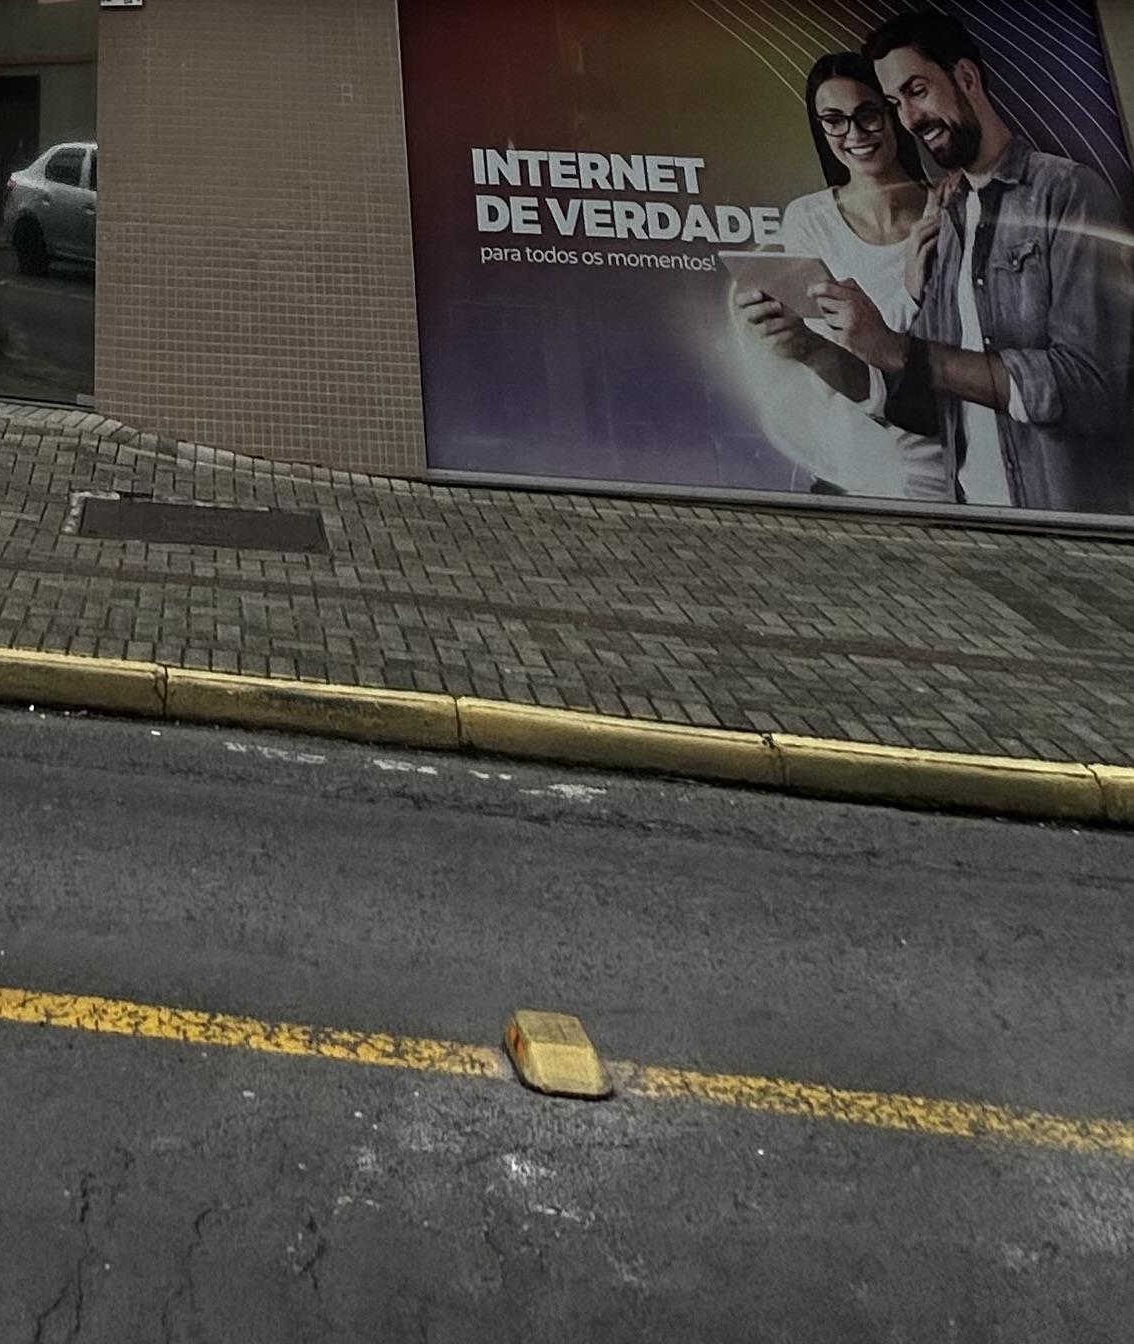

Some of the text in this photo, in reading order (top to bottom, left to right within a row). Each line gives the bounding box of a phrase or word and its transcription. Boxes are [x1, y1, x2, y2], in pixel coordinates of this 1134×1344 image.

[471, 148, 705, 194] INTERNET
[475, 194, 785, 245] DE VERDADE
[480, 245, 716, 271] para todos os momentos!
